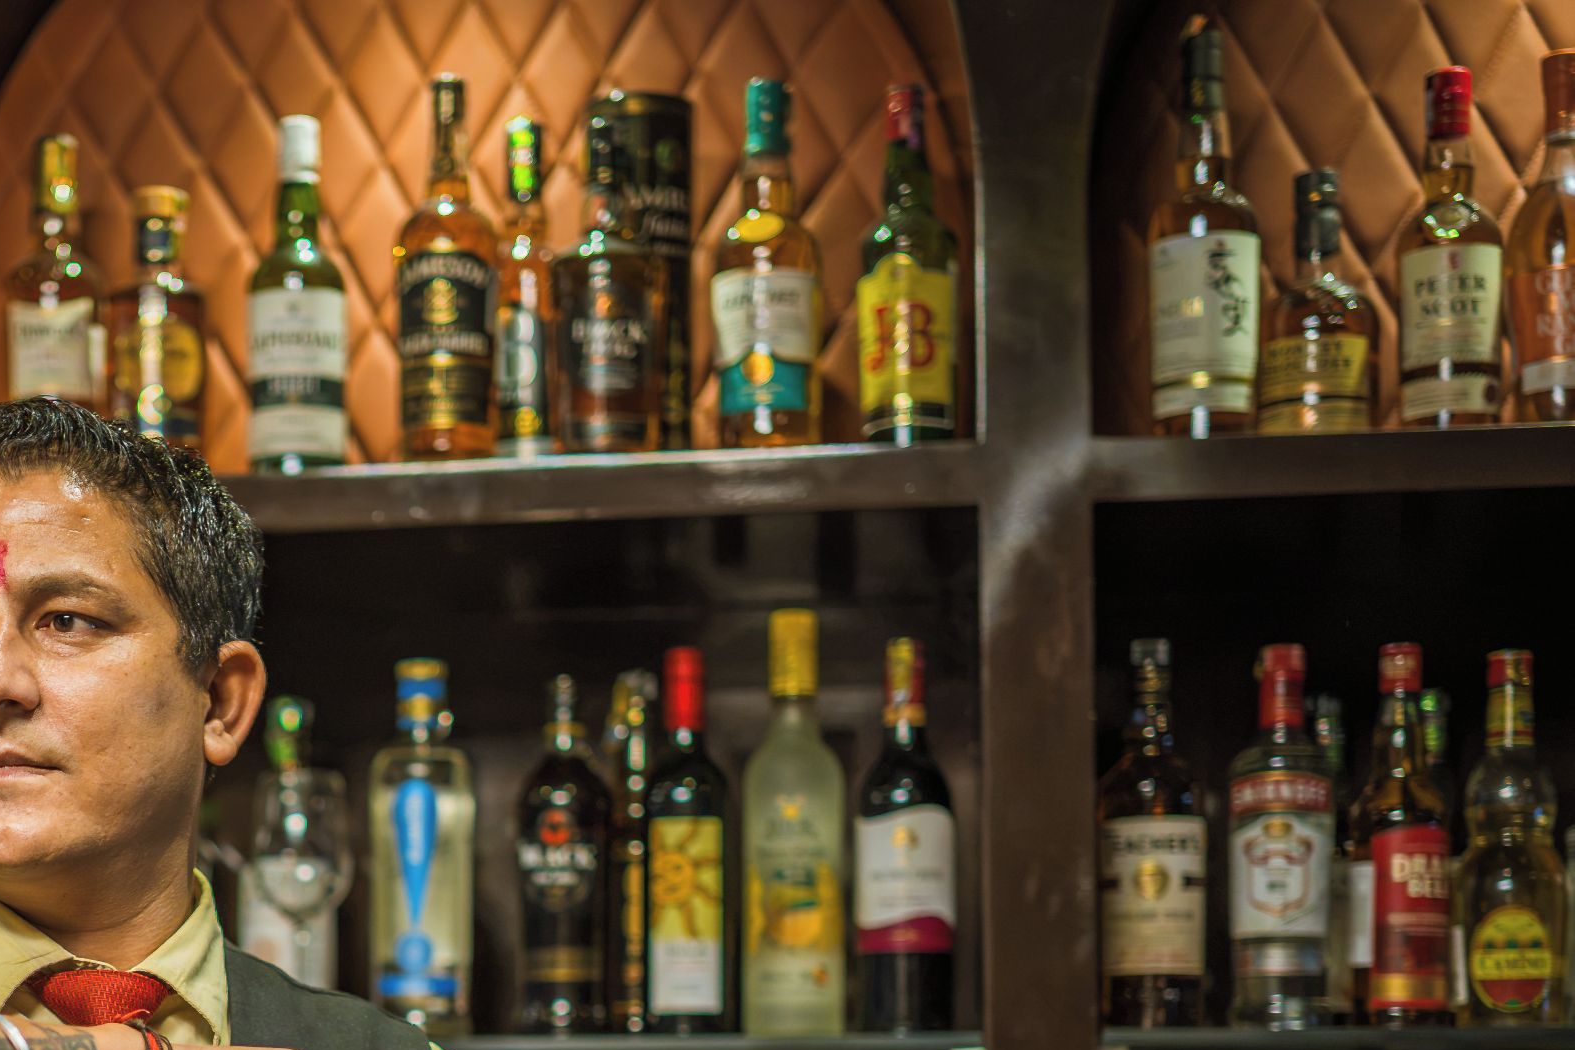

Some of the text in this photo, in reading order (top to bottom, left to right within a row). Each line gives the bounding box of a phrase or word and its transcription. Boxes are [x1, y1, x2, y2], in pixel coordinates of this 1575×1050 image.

[1414, 273, 1488, 296] PETER
[1421, 298, 1482, 316] SCOT
[1390, 853, 1448, 883] DRA
